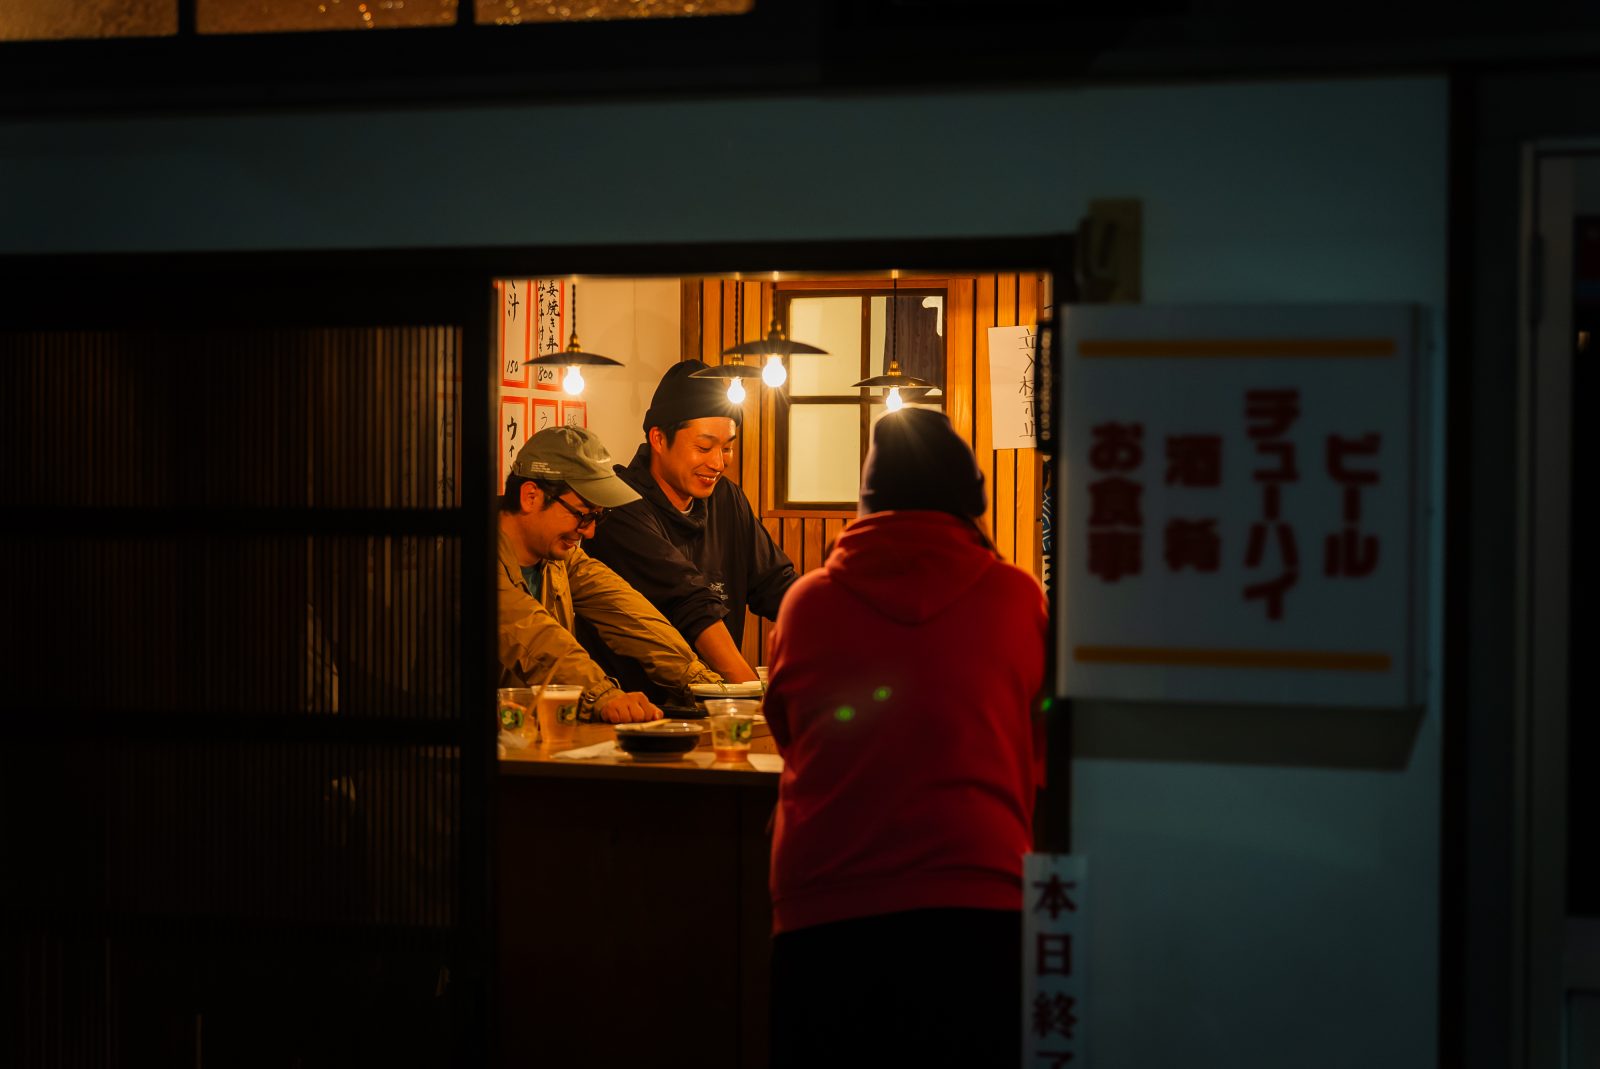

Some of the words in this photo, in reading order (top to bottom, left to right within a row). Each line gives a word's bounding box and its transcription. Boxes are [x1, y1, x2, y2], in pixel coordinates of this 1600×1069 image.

[506, 360, 519, 374] 150
[538, 367, 553, 381] 800
[1087, 421, 1144, 583] お食事
[1243, 387, 1300, 619] チューハイ
[1324, 432, 1381, 578] ビール
